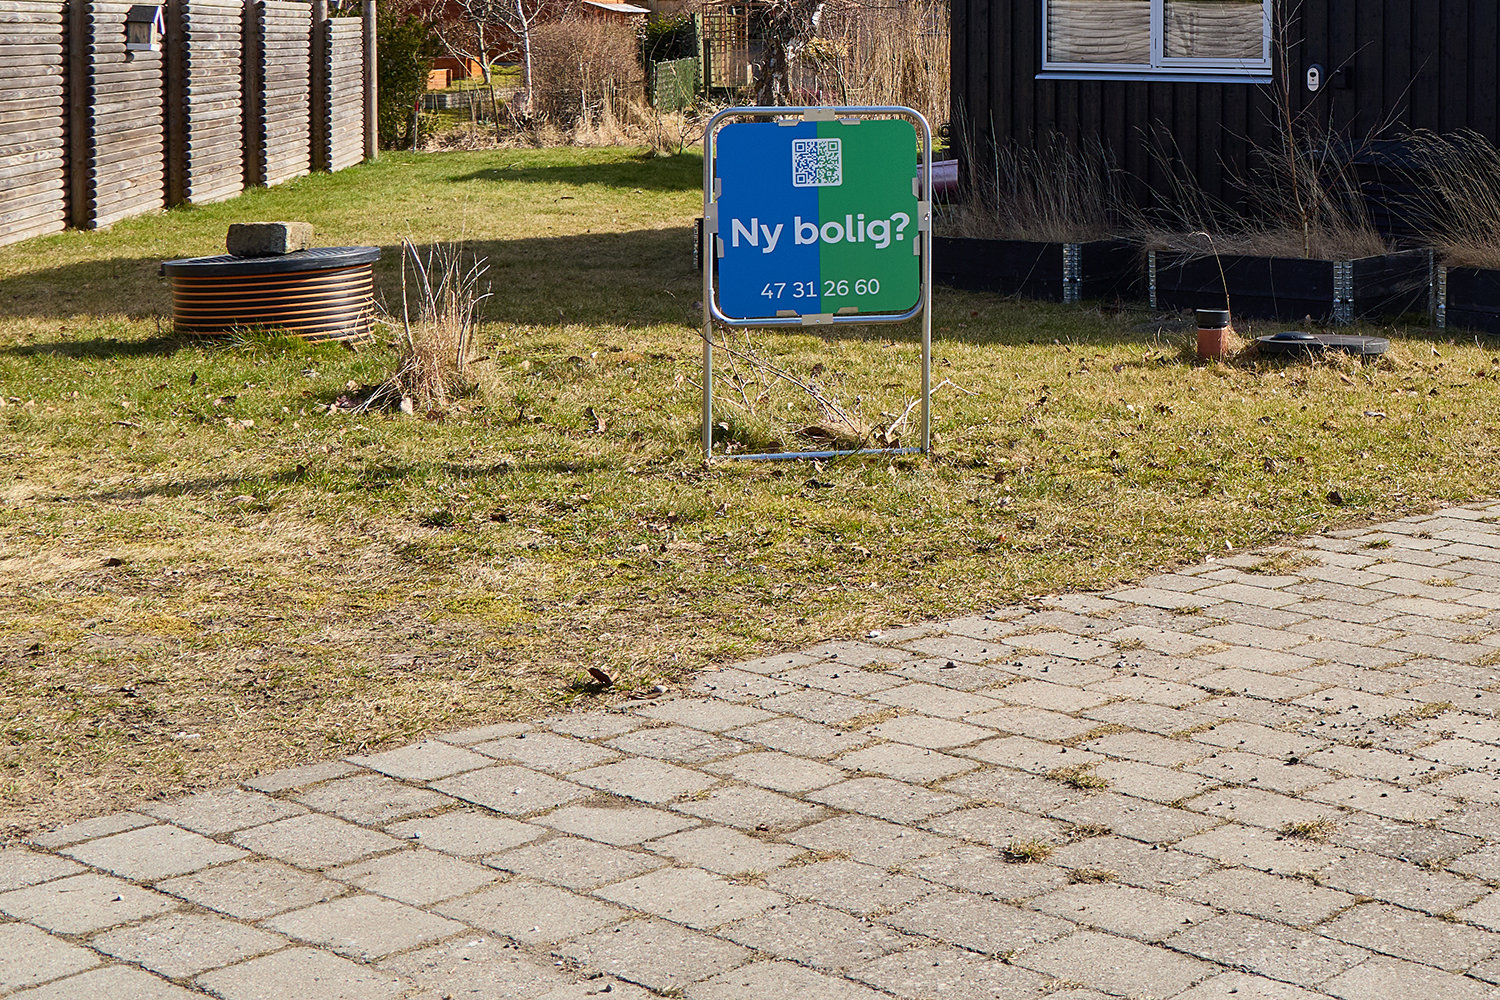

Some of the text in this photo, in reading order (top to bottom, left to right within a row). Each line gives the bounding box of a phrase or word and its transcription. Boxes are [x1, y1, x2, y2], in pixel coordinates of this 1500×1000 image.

[731, 212, 910, 254] Ny bolig?
[760, 278, 880, 299] 47 31 26 60
